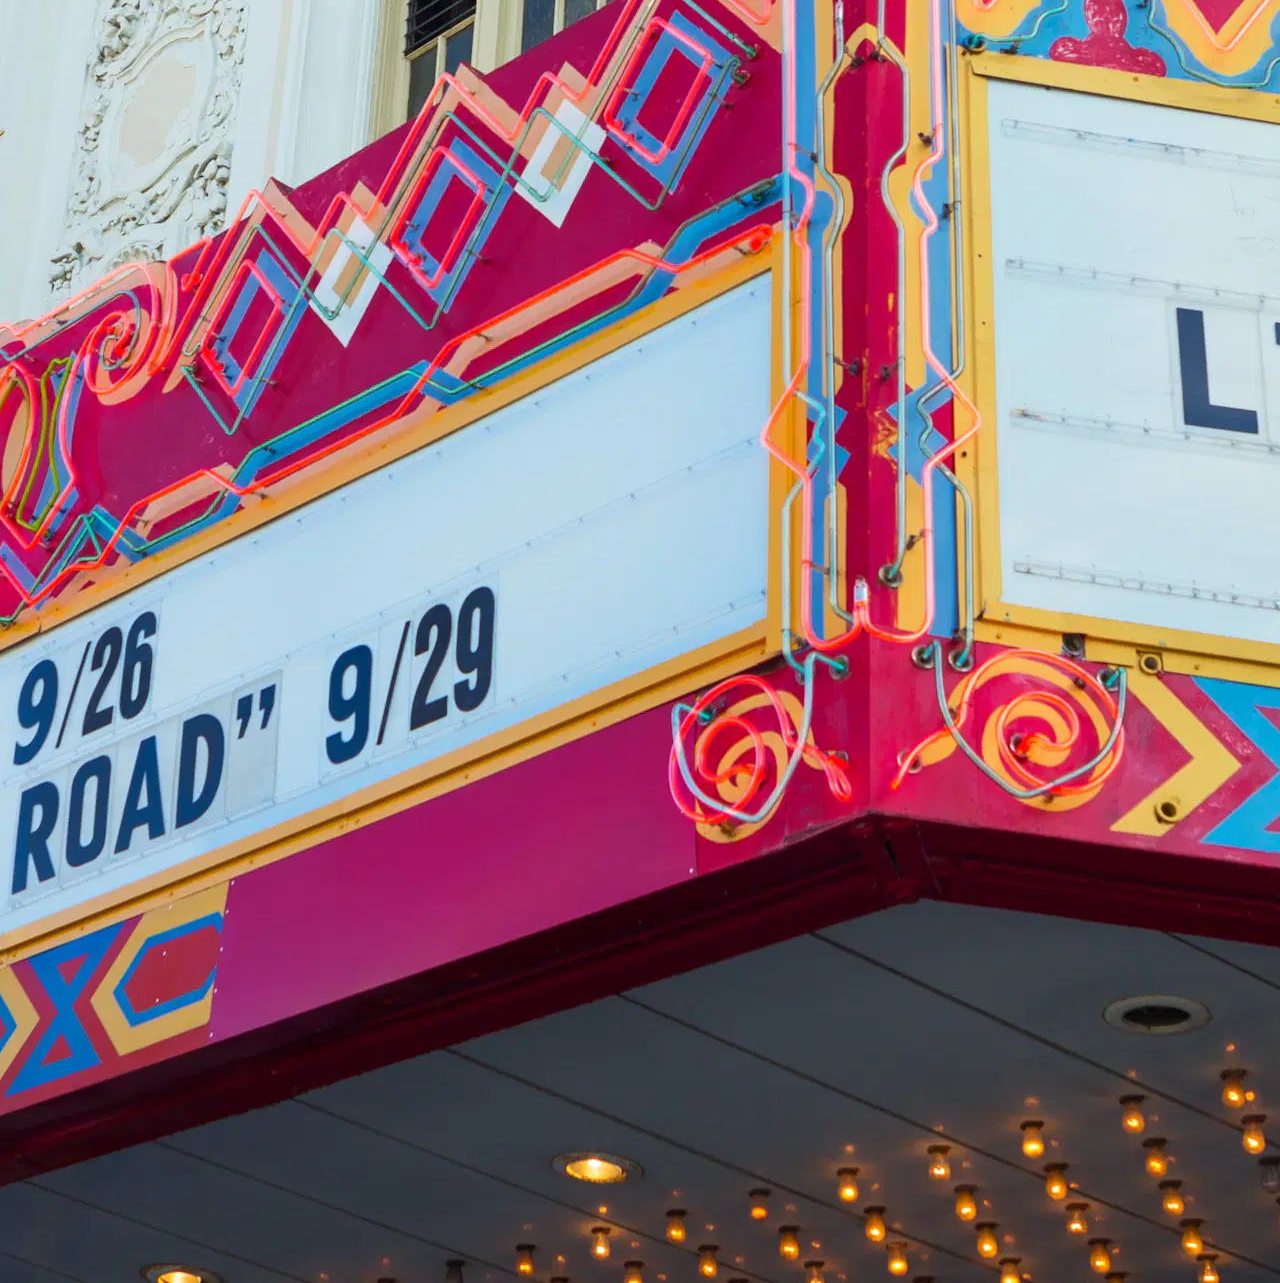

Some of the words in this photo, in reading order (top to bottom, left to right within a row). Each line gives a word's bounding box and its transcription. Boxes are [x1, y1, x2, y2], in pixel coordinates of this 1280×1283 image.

[11, 684, 276, 895] ROAD"
[326, 585, 496, 767] 9/29
[13, 611, 158, 765] 9/26
